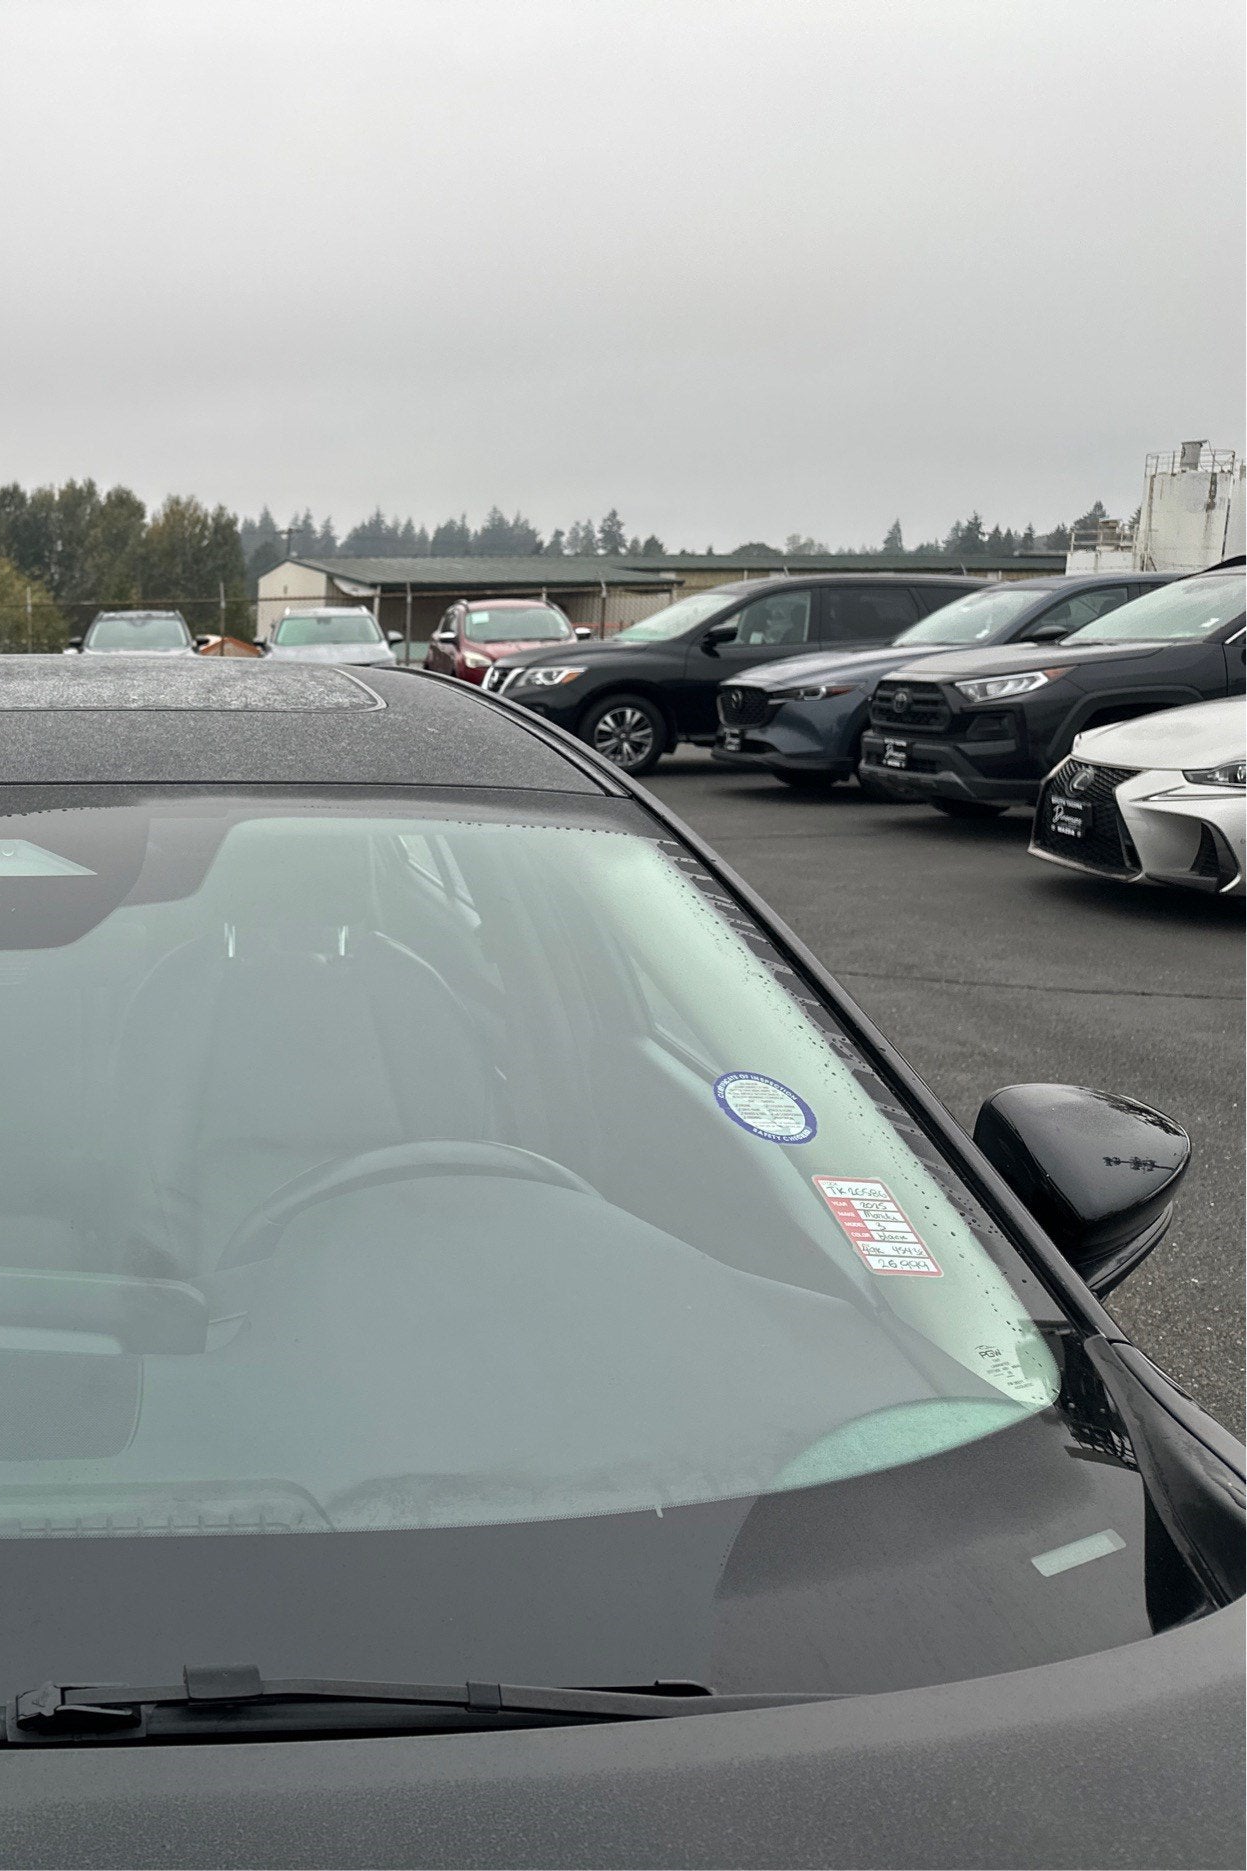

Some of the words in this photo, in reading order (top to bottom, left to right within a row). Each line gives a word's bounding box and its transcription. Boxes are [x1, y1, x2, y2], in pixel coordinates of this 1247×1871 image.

[750, 1075, 798, 1101] INSPECTION
[752, 1127, 781, 1141] SAFETY
[979, 1348, 1002, 1359] PGW
